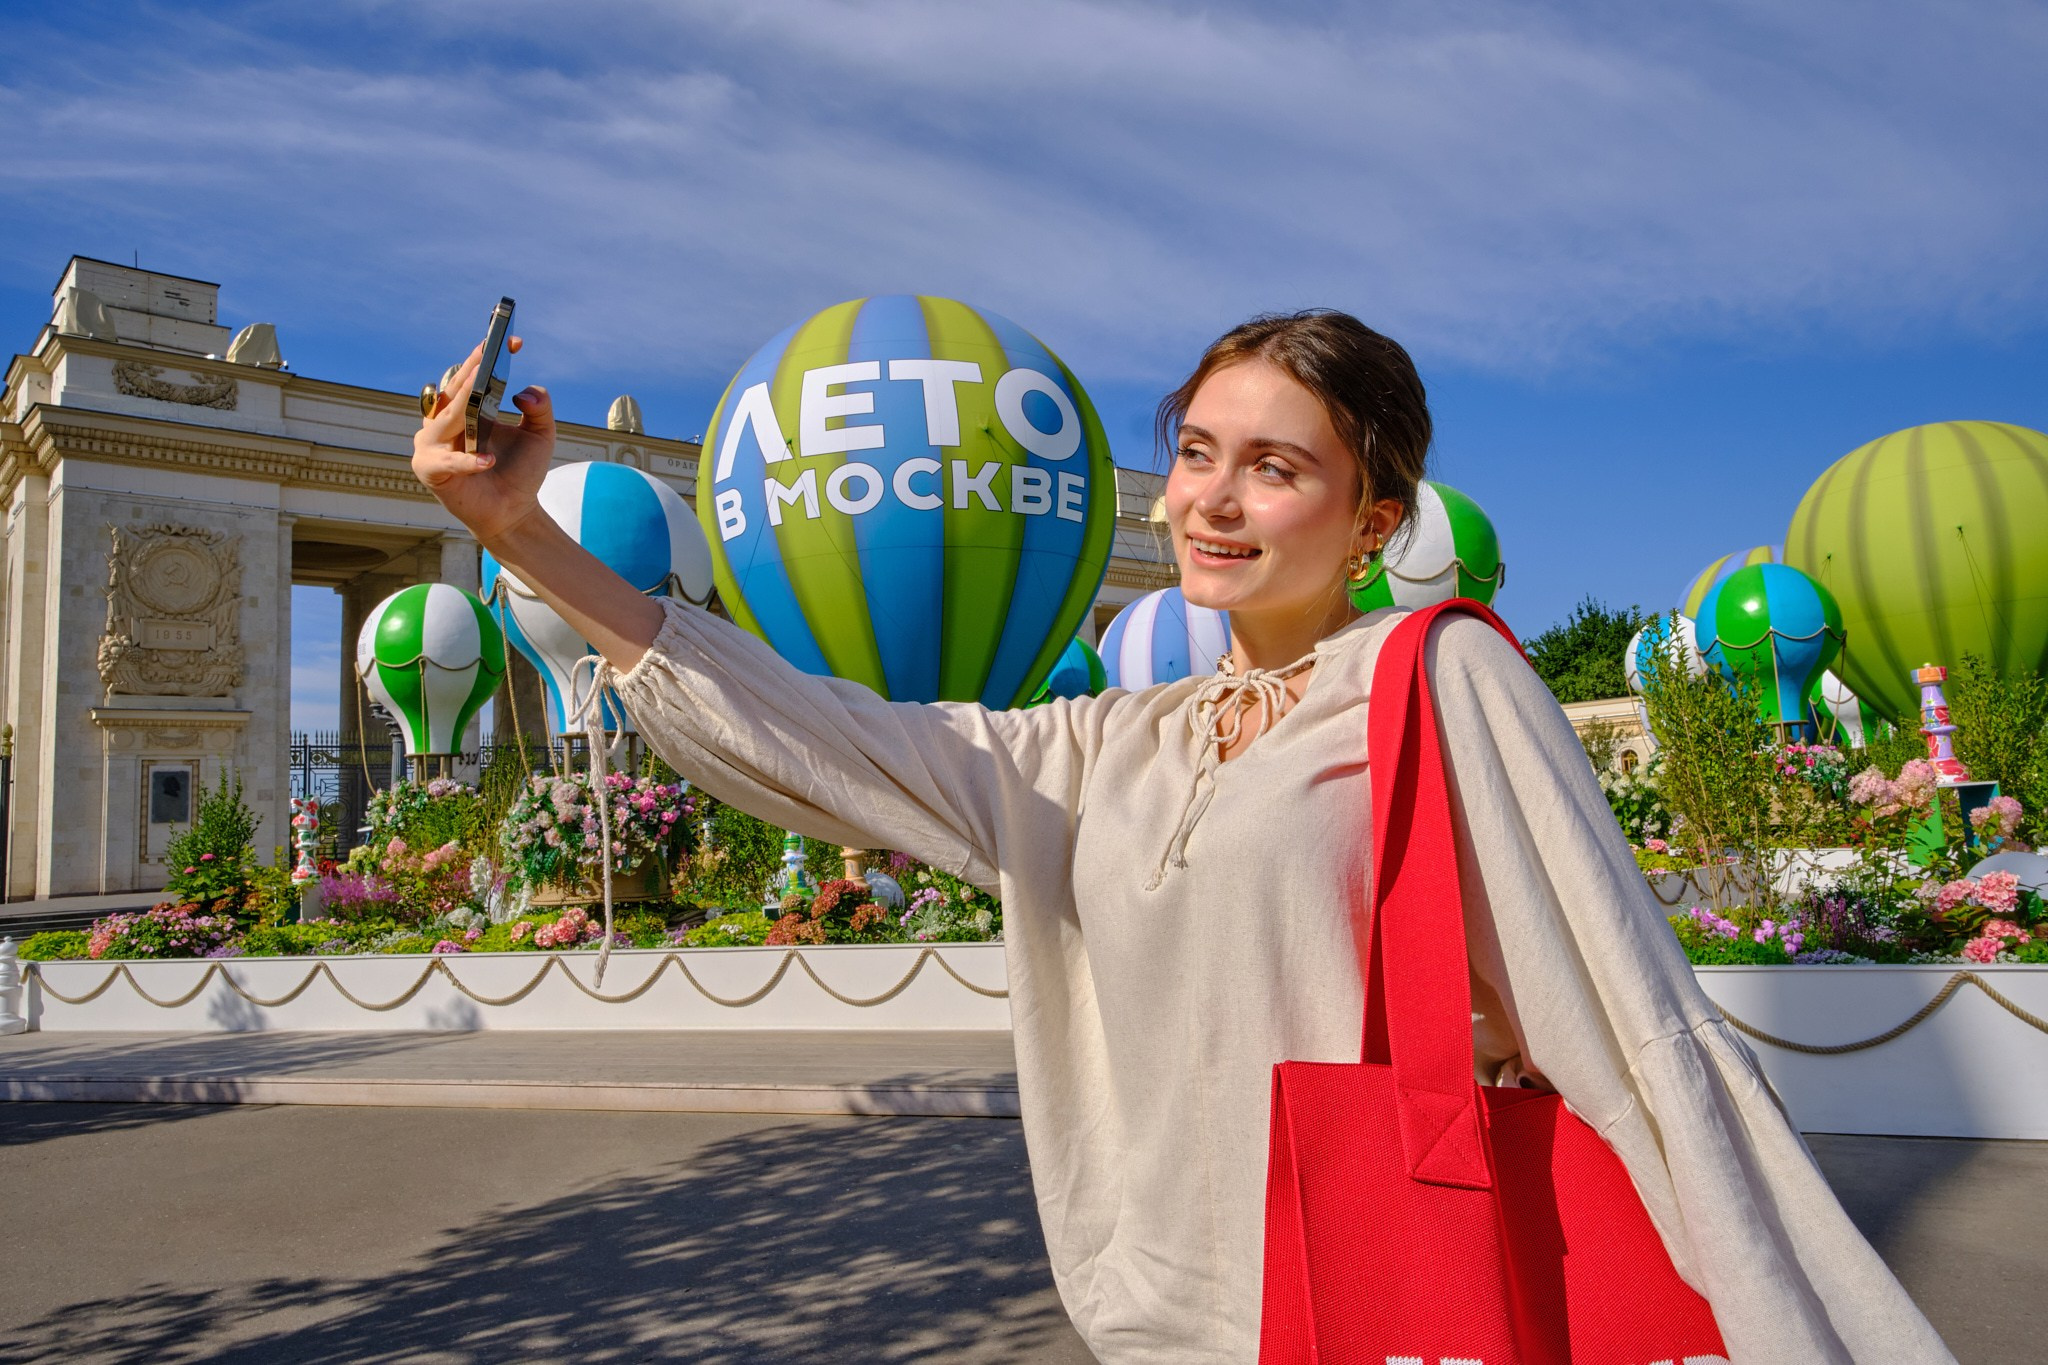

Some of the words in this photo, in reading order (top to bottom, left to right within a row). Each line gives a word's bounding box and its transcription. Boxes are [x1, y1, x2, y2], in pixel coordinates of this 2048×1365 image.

[715, 359, 1082, 484] ЛЕТО
[715, 488, 747, 542] В
[764, 457, 1086, 527] МОСКВЕ
